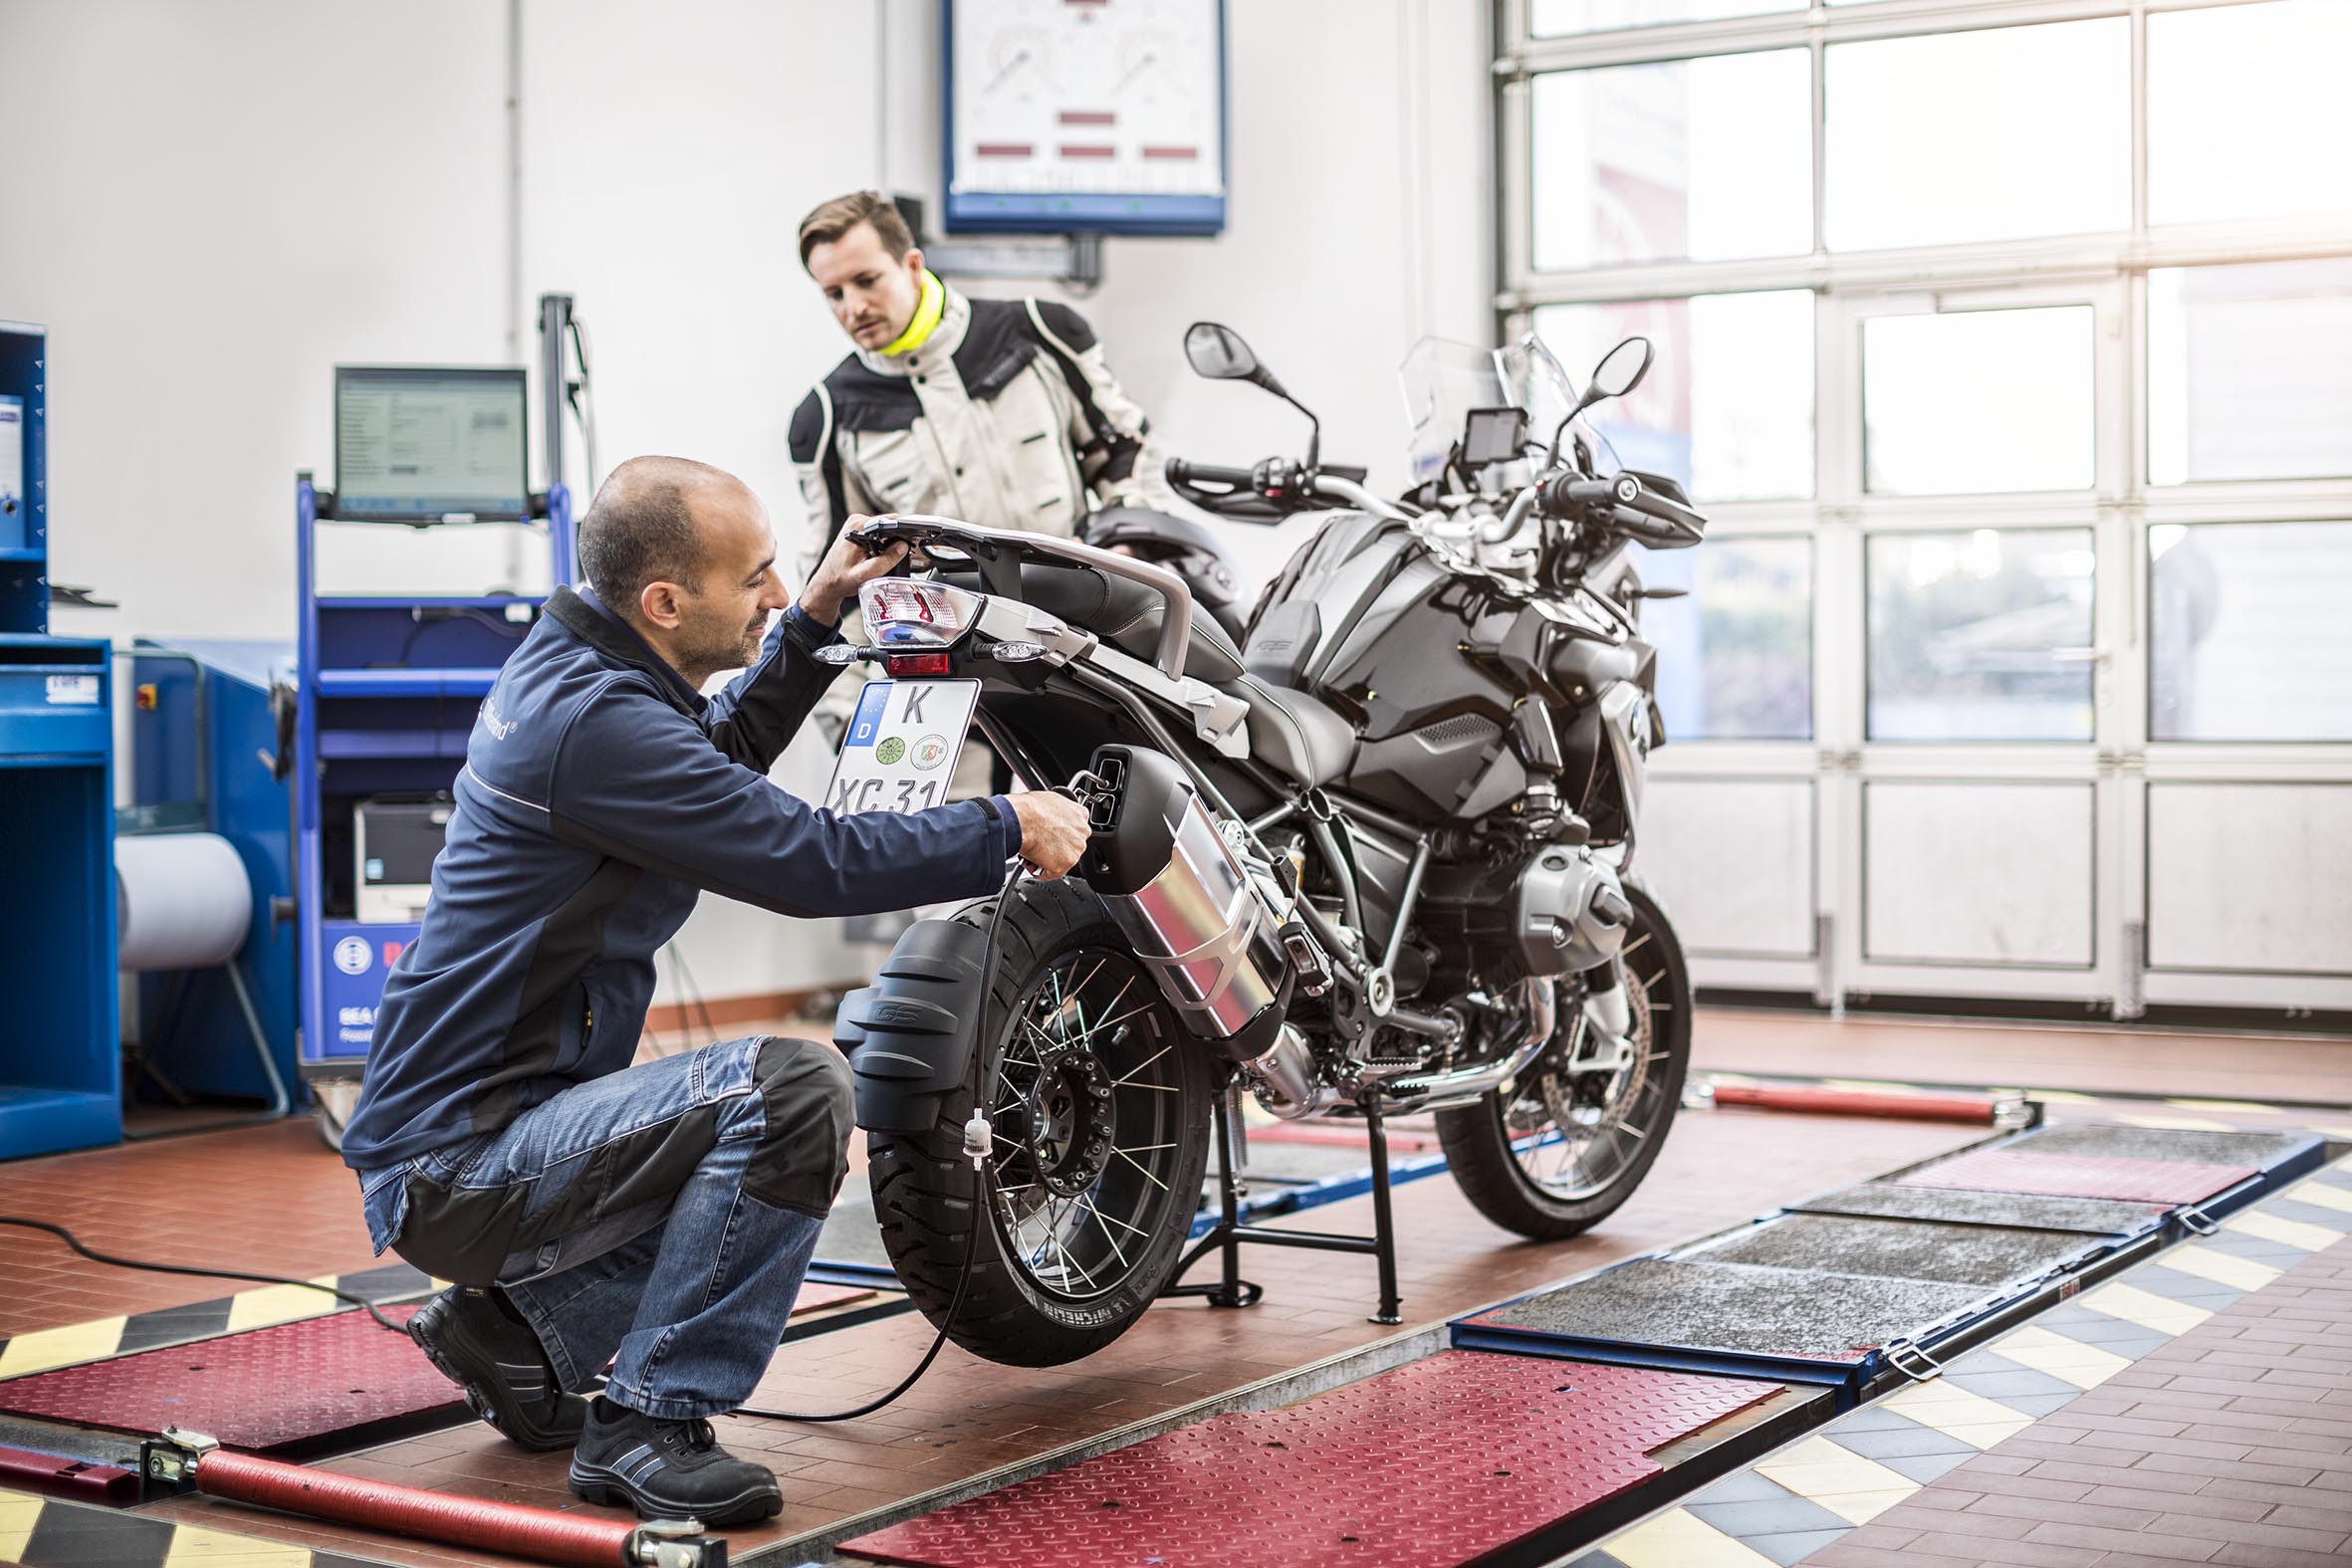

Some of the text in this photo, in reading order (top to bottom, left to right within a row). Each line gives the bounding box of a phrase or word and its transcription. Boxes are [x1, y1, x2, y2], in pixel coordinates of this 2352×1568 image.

[901, 685, 933, 724] K
[857, 723, 871, 739] D
[831, 779, 936, 814] XC 31
[1044, 1302, 1114, 1325] MICHELIN
